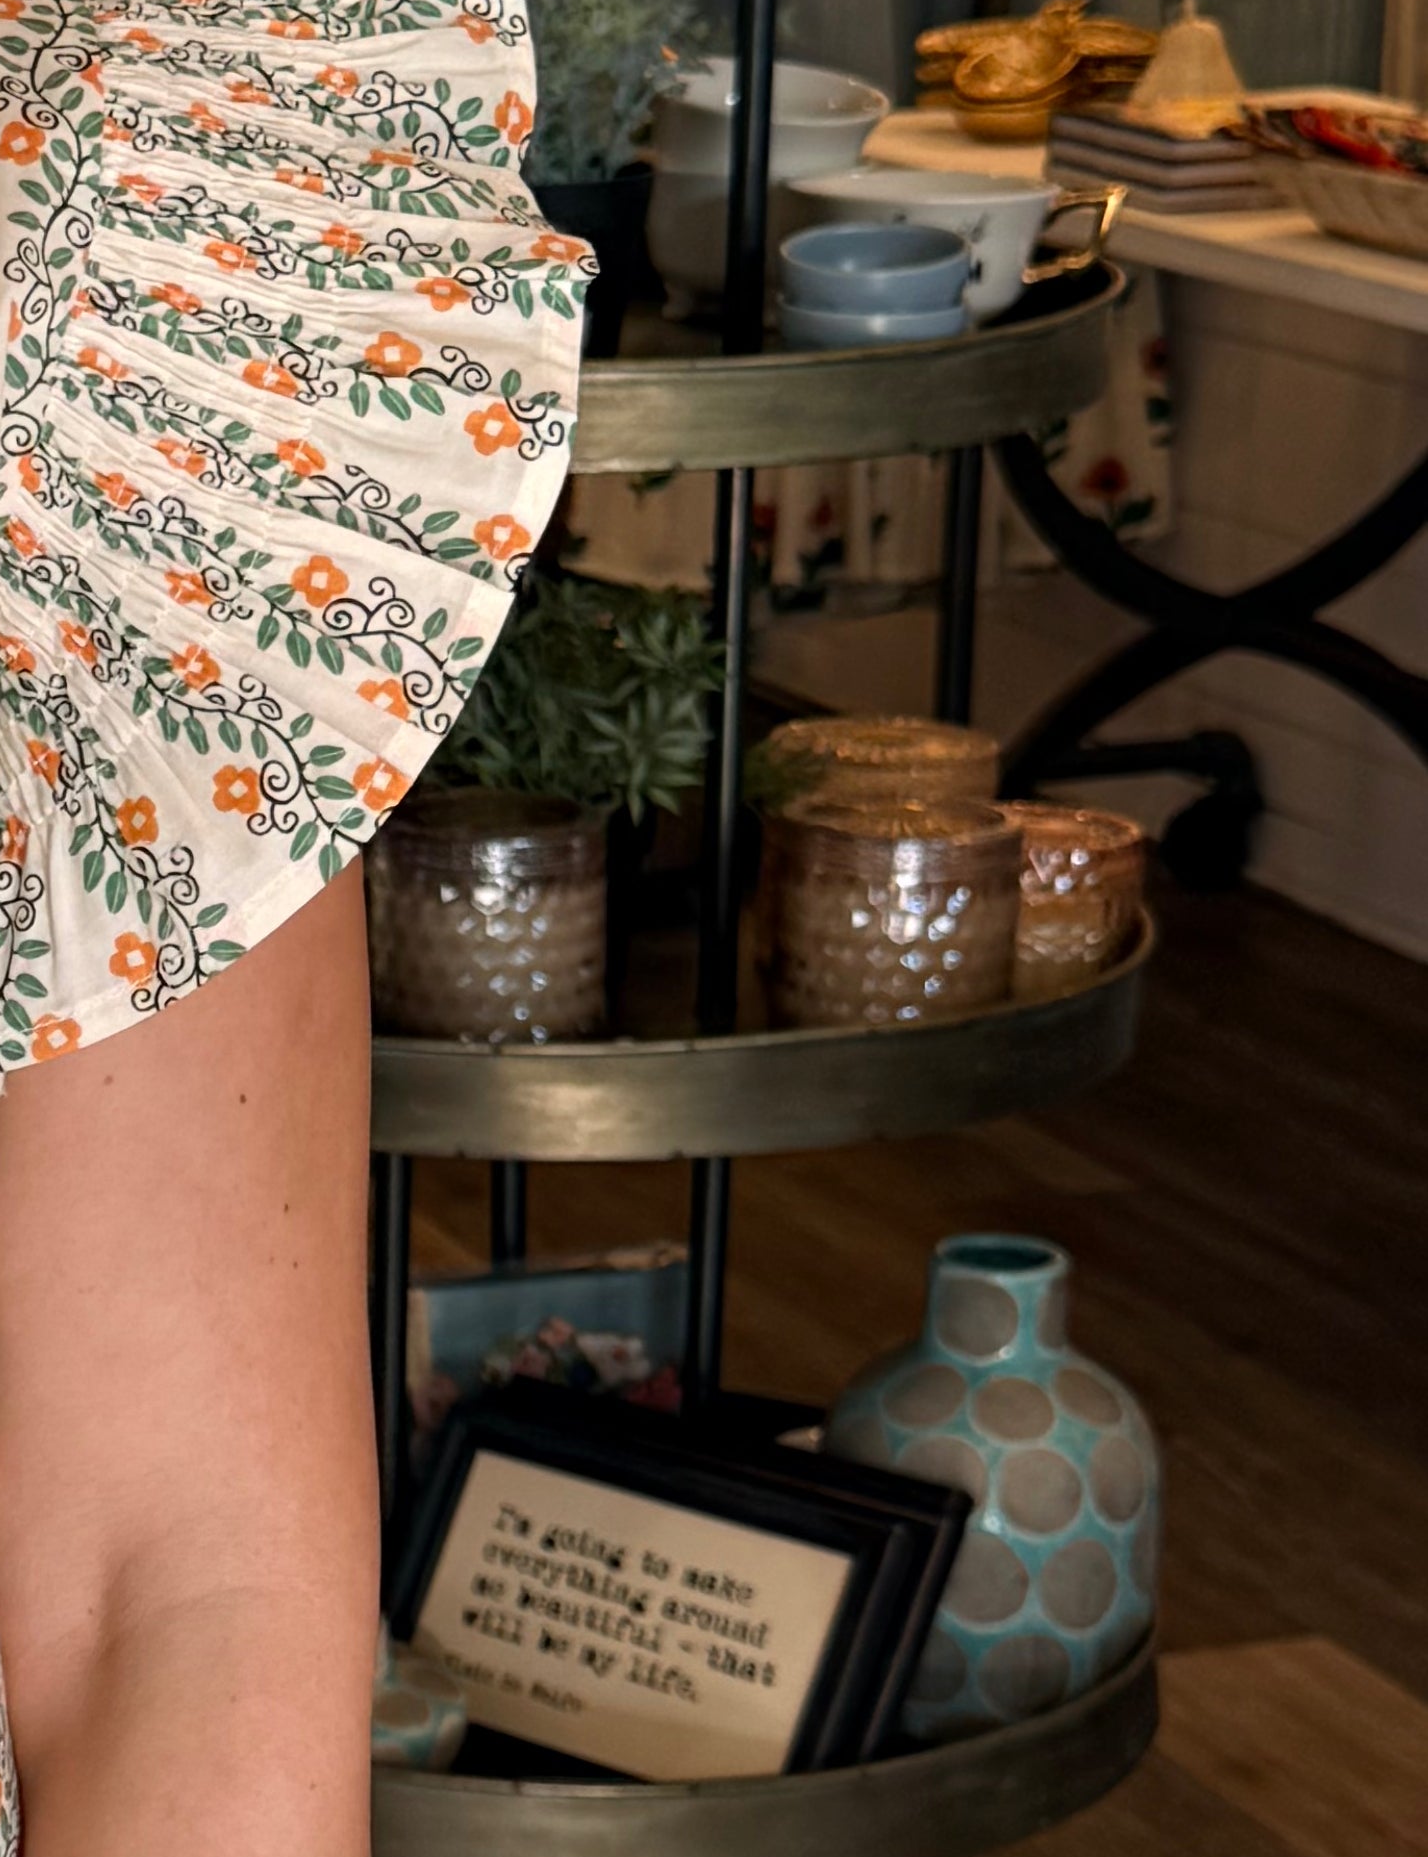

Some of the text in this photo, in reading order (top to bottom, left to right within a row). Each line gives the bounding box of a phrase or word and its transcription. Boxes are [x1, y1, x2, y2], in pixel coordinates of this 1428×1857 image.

[482, 1540, 769, 1650] everything around
[540, 1526, 626, 1572] going
[642, 1550, 670, 1581] to
[683, 1567, 755, 1606] make
[462, 1607, 523, 1646] will
[538, 1627, 569, 1658] be
[579, 1645, 617, 1678] my
[517, 1585, 662, 1654] beautiful
[706, 1644, 776, 1687] that
